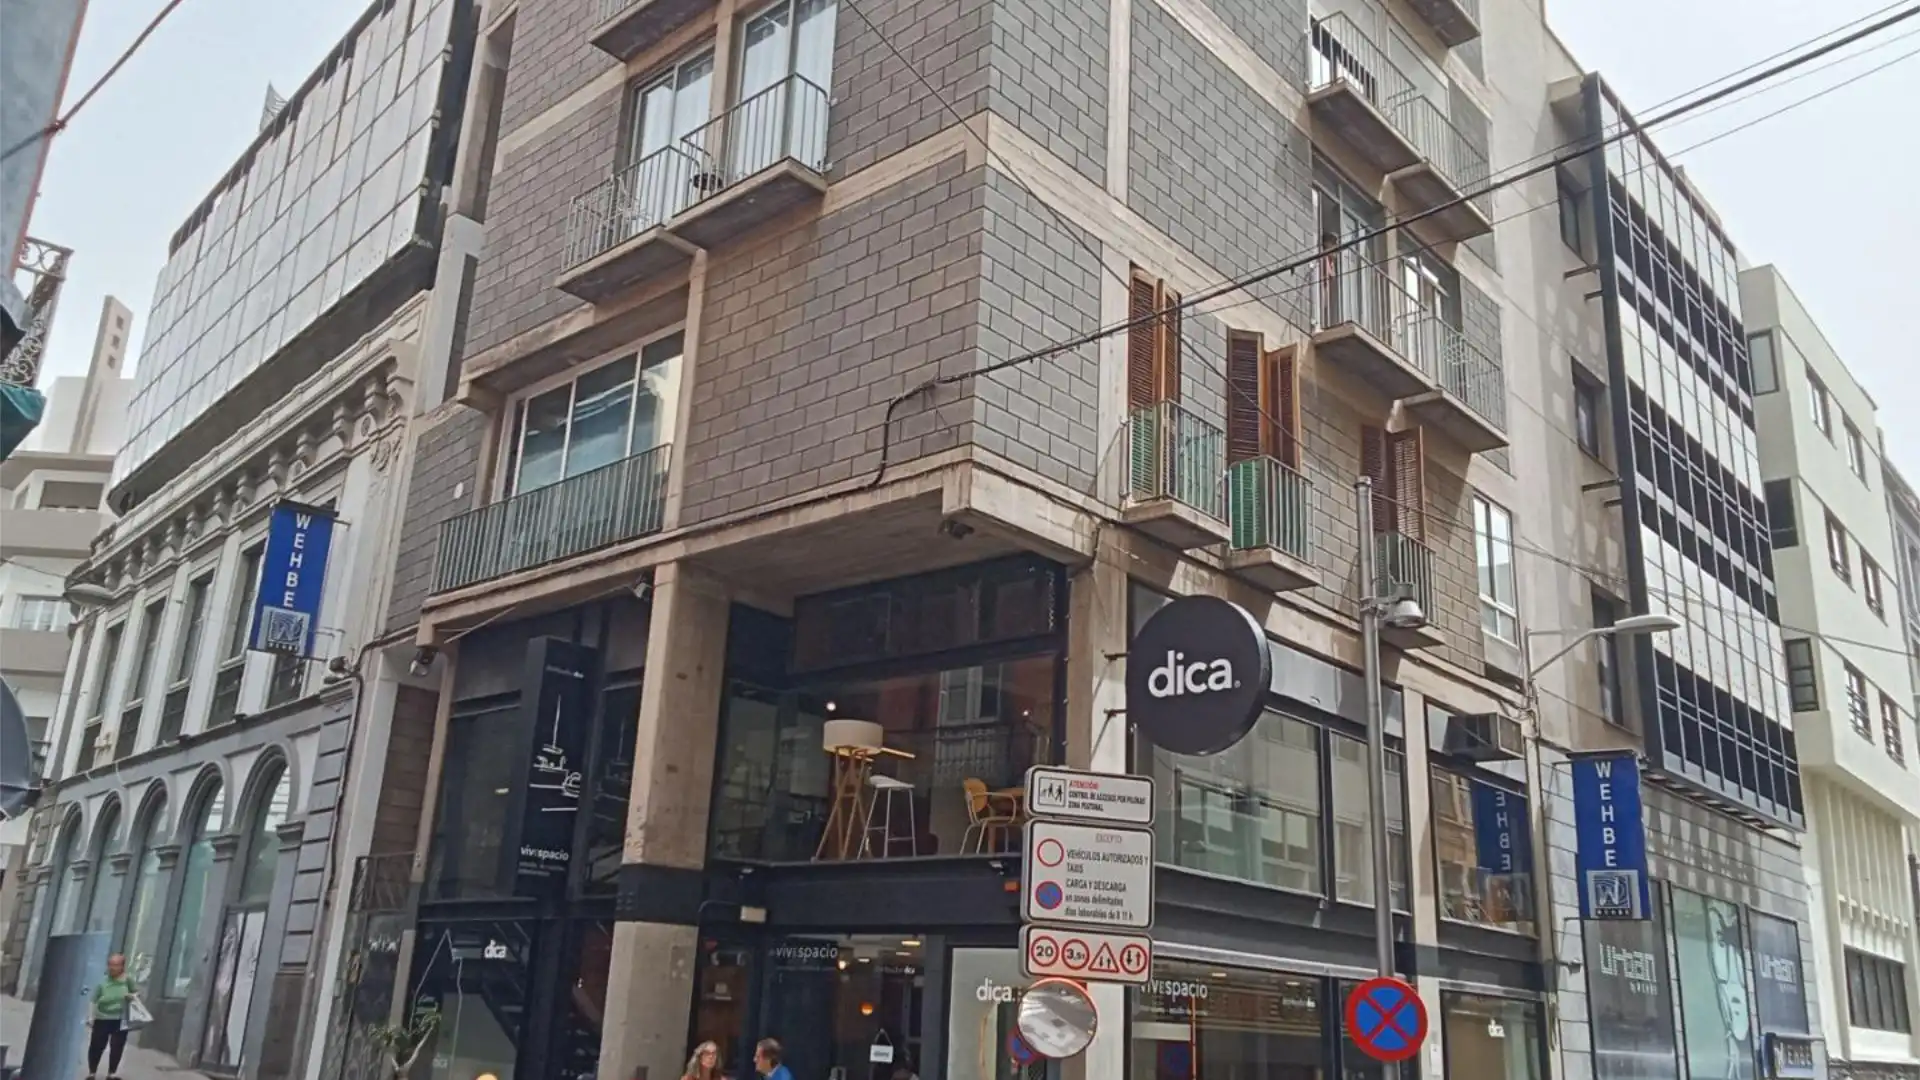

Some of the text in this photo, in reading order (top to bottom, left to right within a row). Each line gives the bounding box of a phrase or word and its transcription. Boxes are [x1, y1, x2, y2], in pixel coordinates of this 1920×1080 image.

[283, 513, 312, 608] WEHBE
[1068, 790, 1089, 799] CONTROL
[1090, 792, 1097, 800] DE
[1117, 794, 1126, 803] POR
[1068, 800, 1081, 809] ZONA
[1594, 760, 1617, 867] WEHBE
[1102, 851, 1143, 866] AUTORIZADOS
[1144, 855, 1149, 866] Y
[1066, 862, 1084, 873] TAXIS
[1066, 878, 1127, 892] CARGA Y DESCARGA
[1073, 894, 1090, 904] zonas
[1036, 945, 1054, 957] 20
